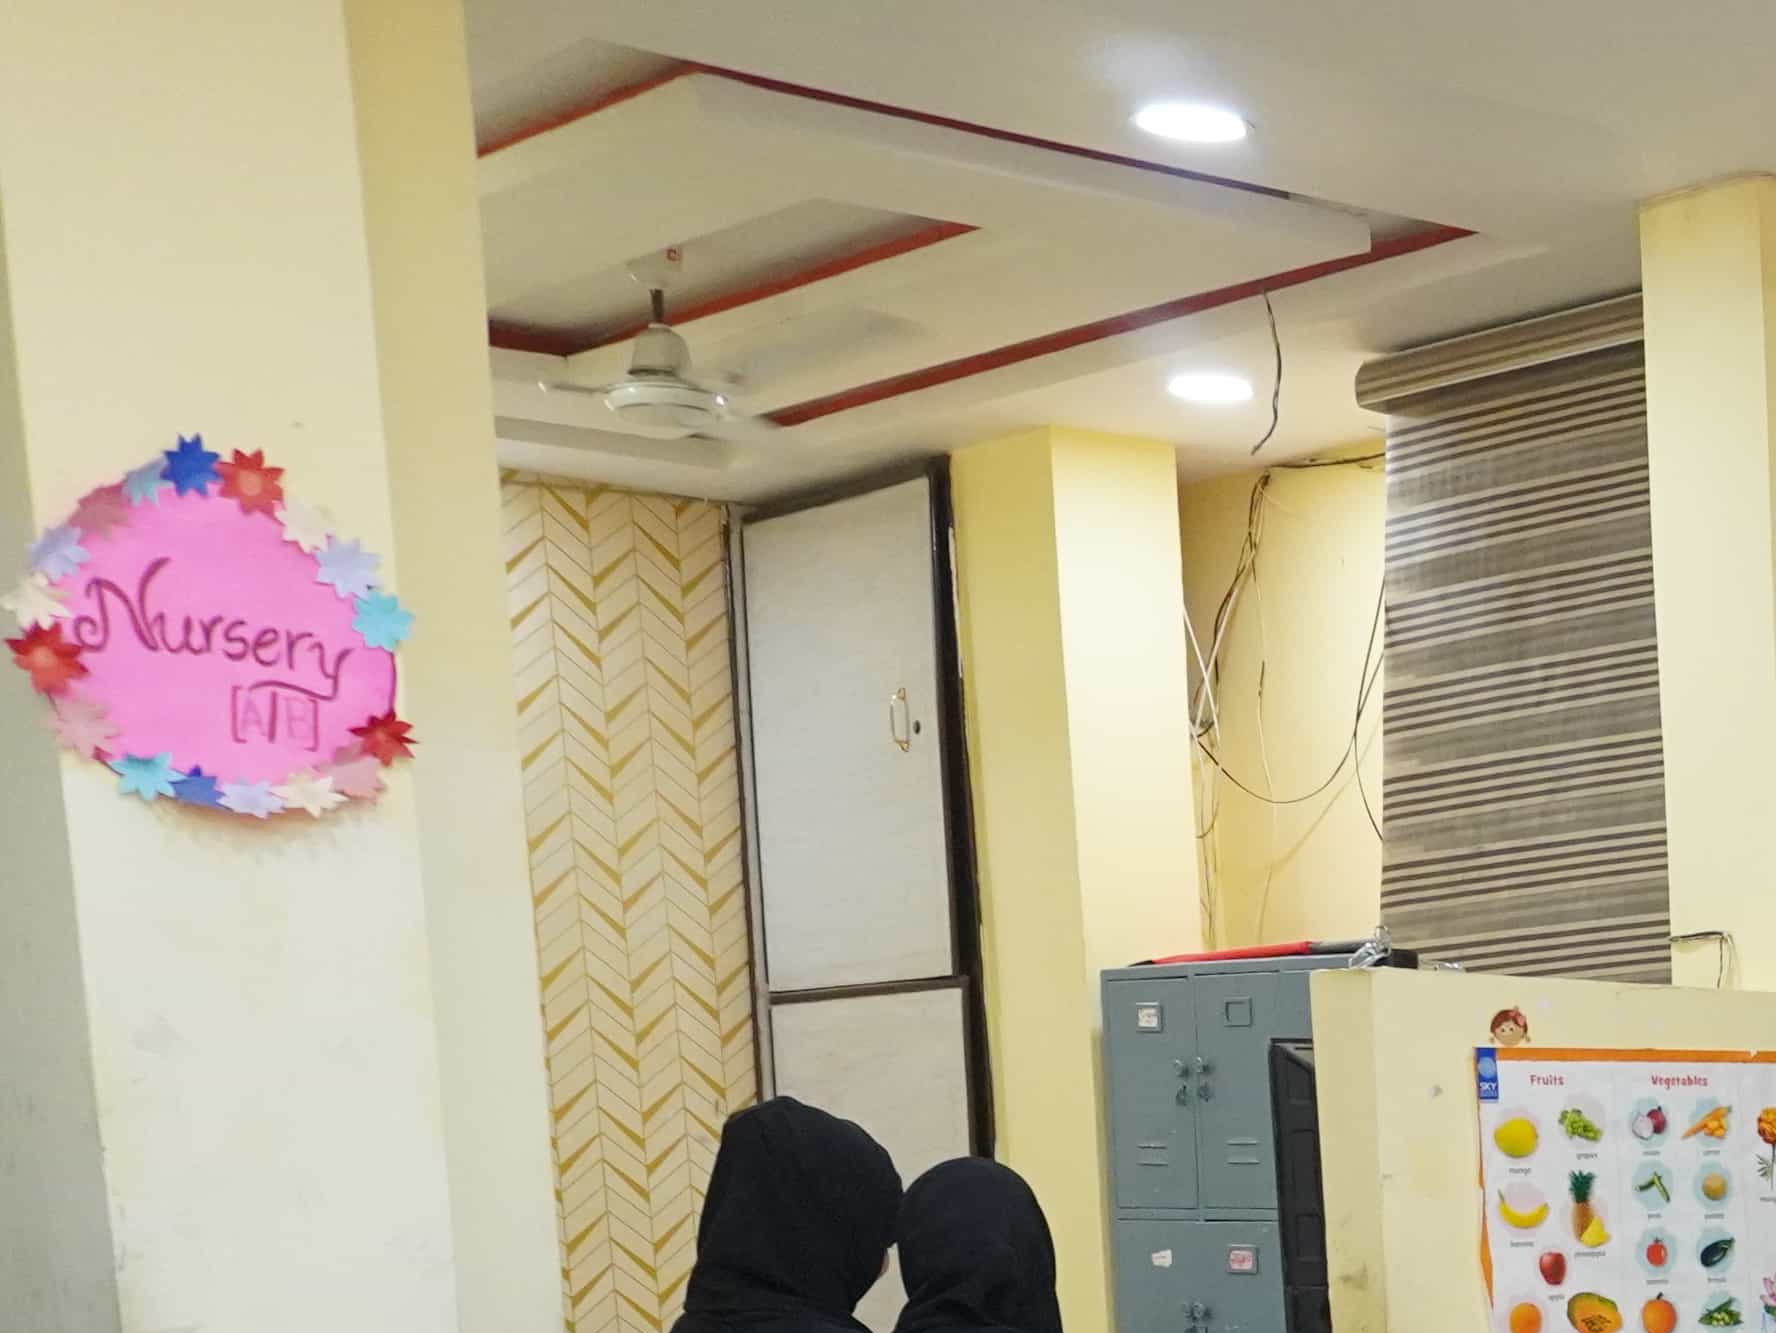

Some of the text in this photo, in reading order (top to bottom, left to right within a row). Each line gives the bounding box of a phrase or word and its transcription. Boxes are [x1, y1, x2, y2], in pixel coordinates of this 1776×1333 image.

[73, 557, 356, 702] Nursery
[1529, 1074, 1565, 1086] Fruits
[1651, 1074, 1708, 1090] Vegetables
